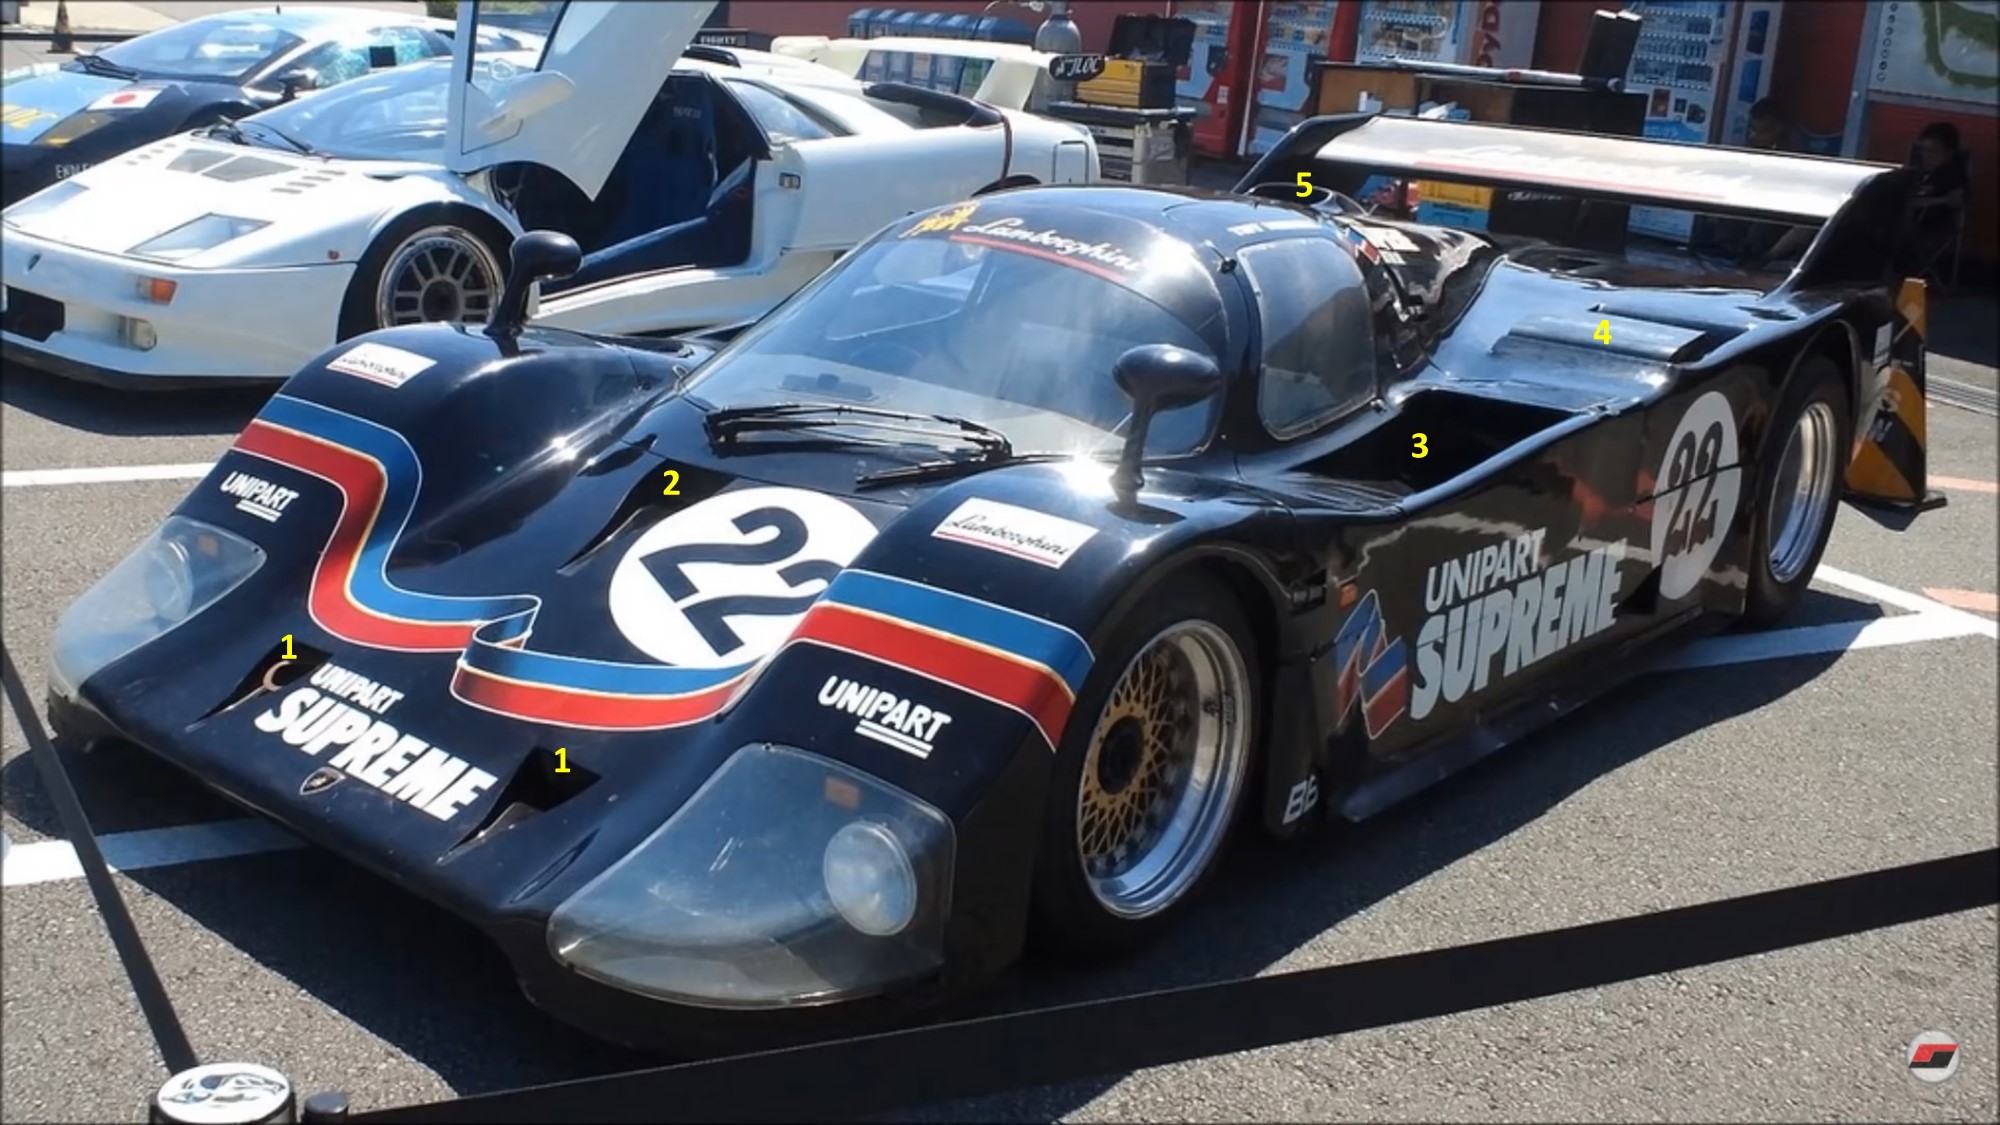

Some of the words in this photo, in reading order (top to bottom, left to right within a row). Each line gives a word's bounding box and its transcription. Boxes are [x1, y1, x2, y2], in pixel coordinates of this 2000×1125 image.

[963, 217, 1142, 272] Lamborghini
[220, 470, 300, 511] UNIPART
[1661, 421, 1724, 568] 22
[945, 514, 1070, 556] Lamborghini
[1425, 527, 1547, 613] UNIPART
[638, 506, 847, 657] 22
[1410, 538, 1628, 720] SUPREME
[310, 662, 405, 715] UNIPART
[818, 675, 952, 742] UNIPART
[254, 687, 499, 821] SUPREME
